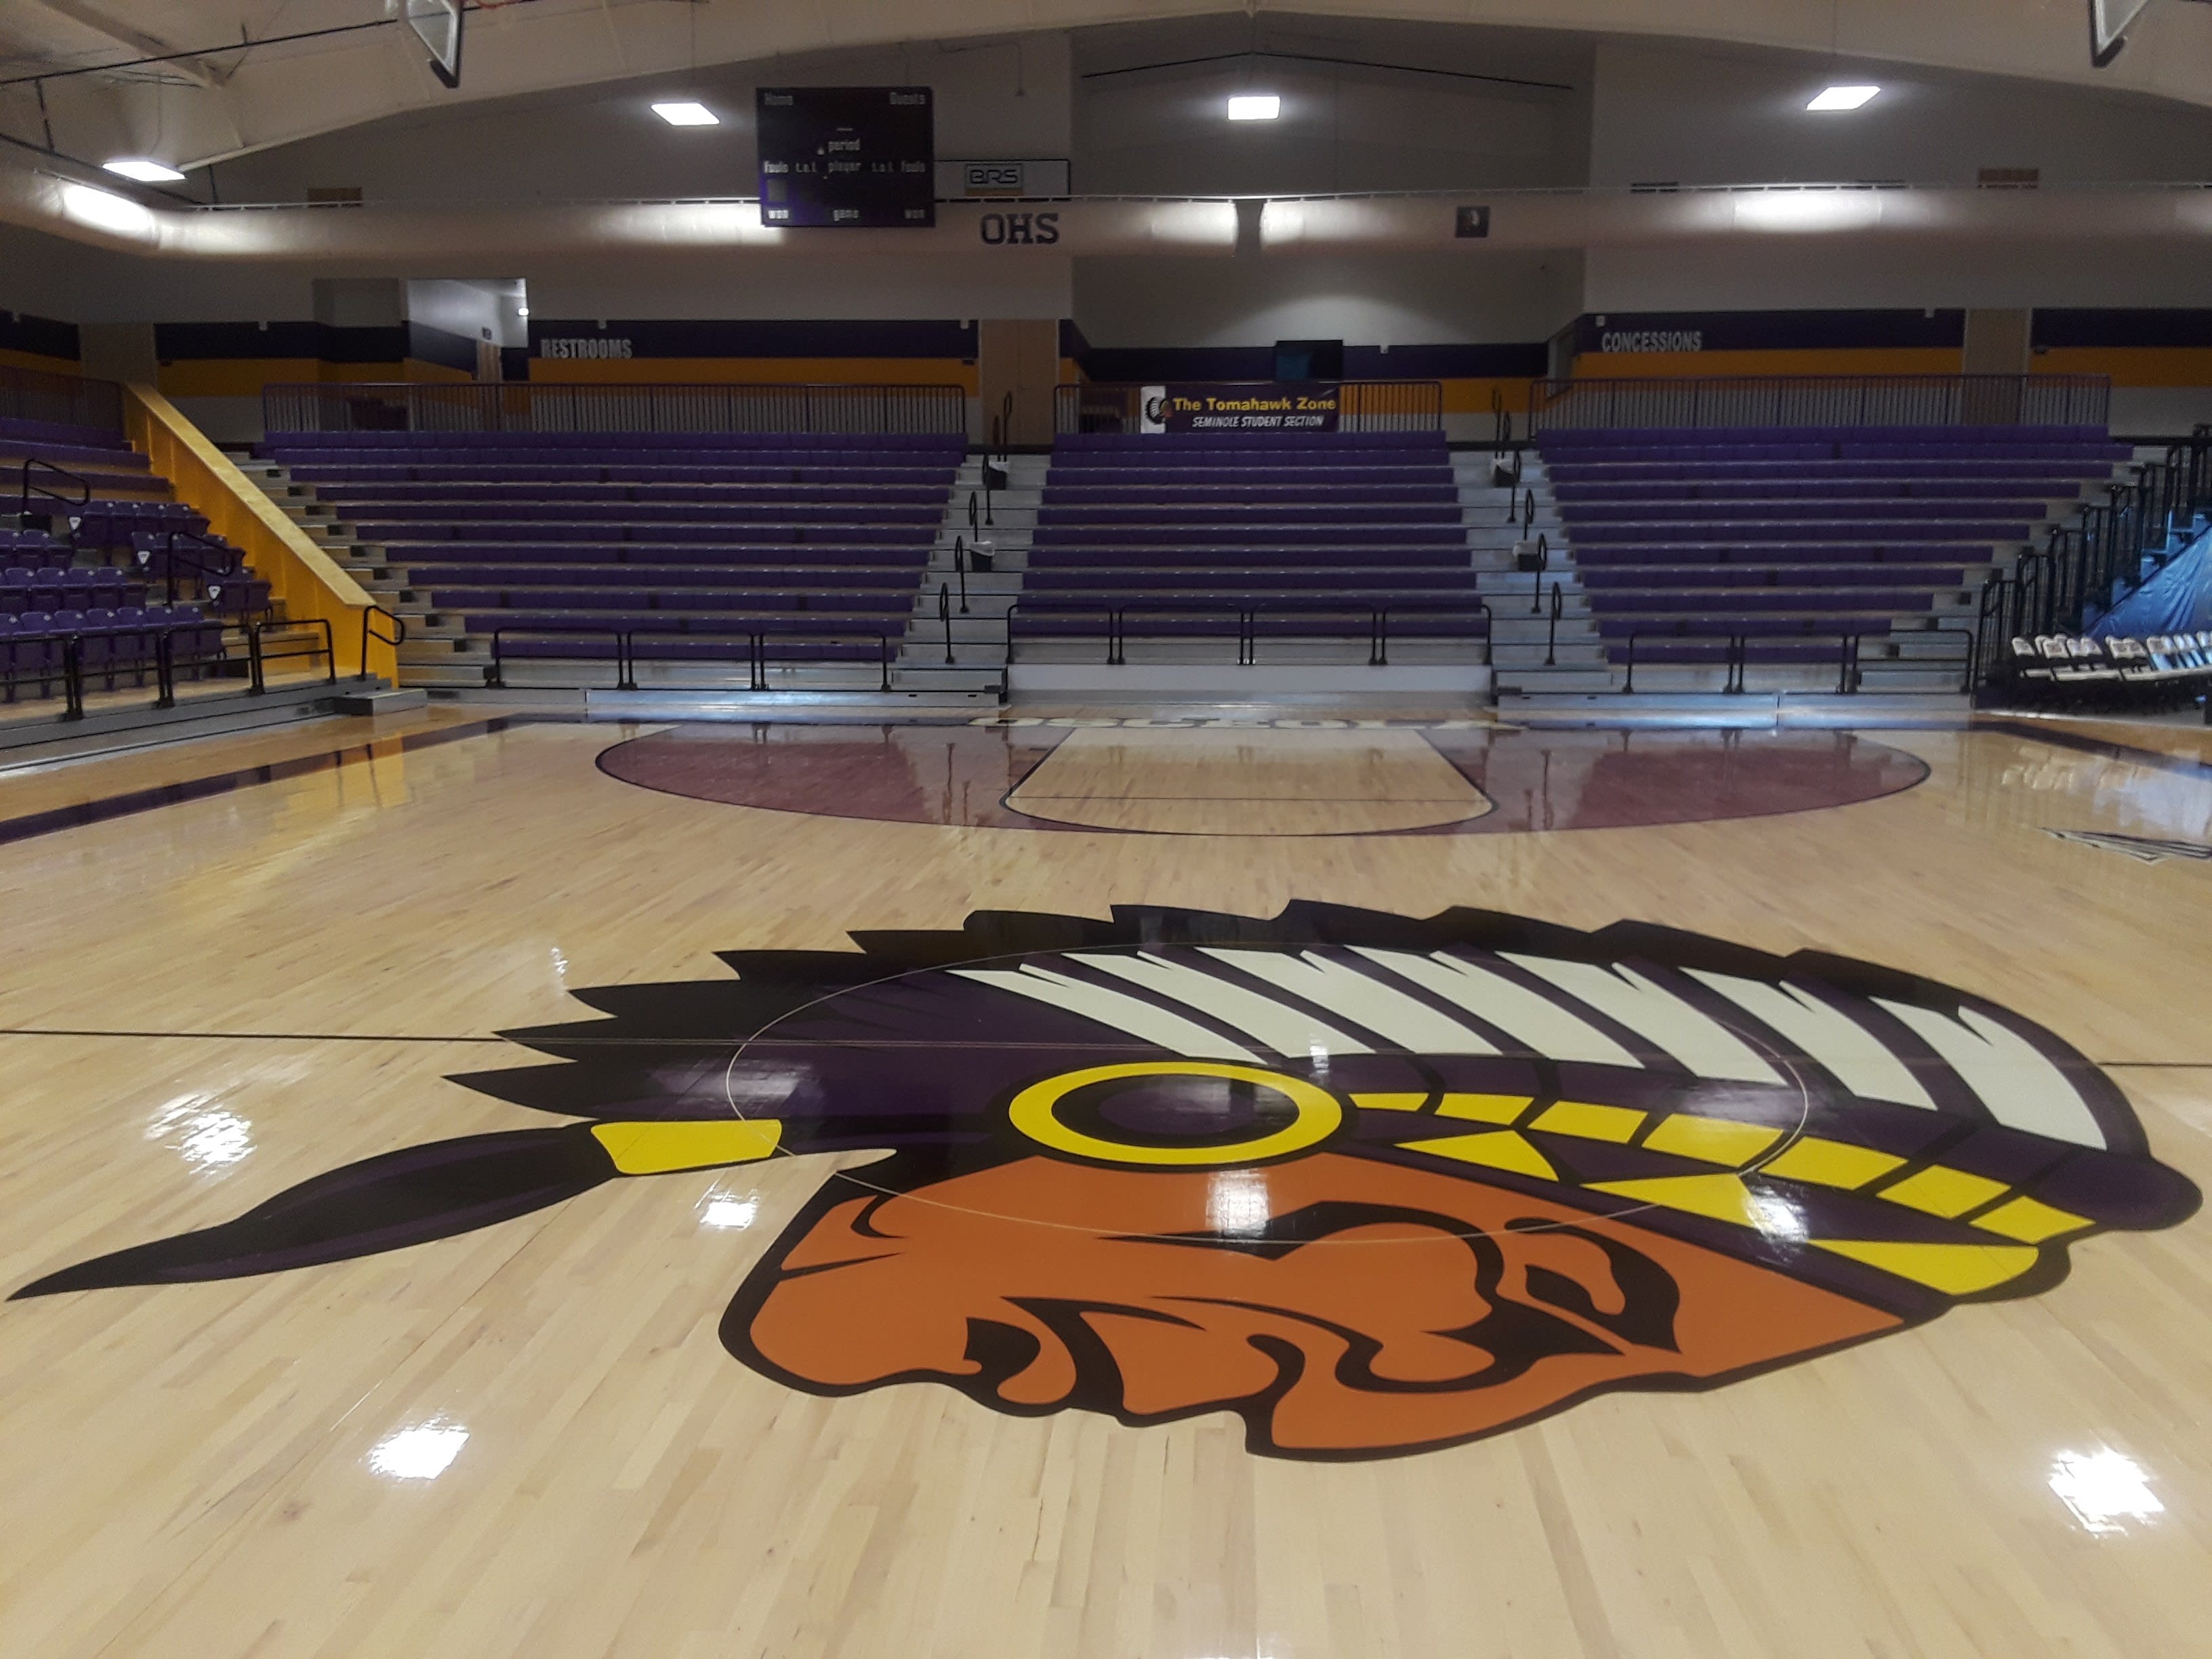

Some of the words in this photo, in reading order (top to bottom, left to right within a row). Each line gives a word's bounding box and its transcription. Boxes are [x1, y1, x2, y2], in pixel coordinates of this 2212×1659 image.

[981, 212, 1059, 245] OHS
[541, 339, 633, 359] RESTROOMS
[1602, 331, 1703, 352] CONCESSIONS
[1172, 398, 1201, 411] The
[1206, 396, 1291, 411] Tomahawk
[1296, 397, 1337, 411] Zone
[1192, 416, 1239, 428] SEMINOLE
[1240, 415, 1282, 428] STUDENT
[1284, 415, 1324, 427] SECTION
